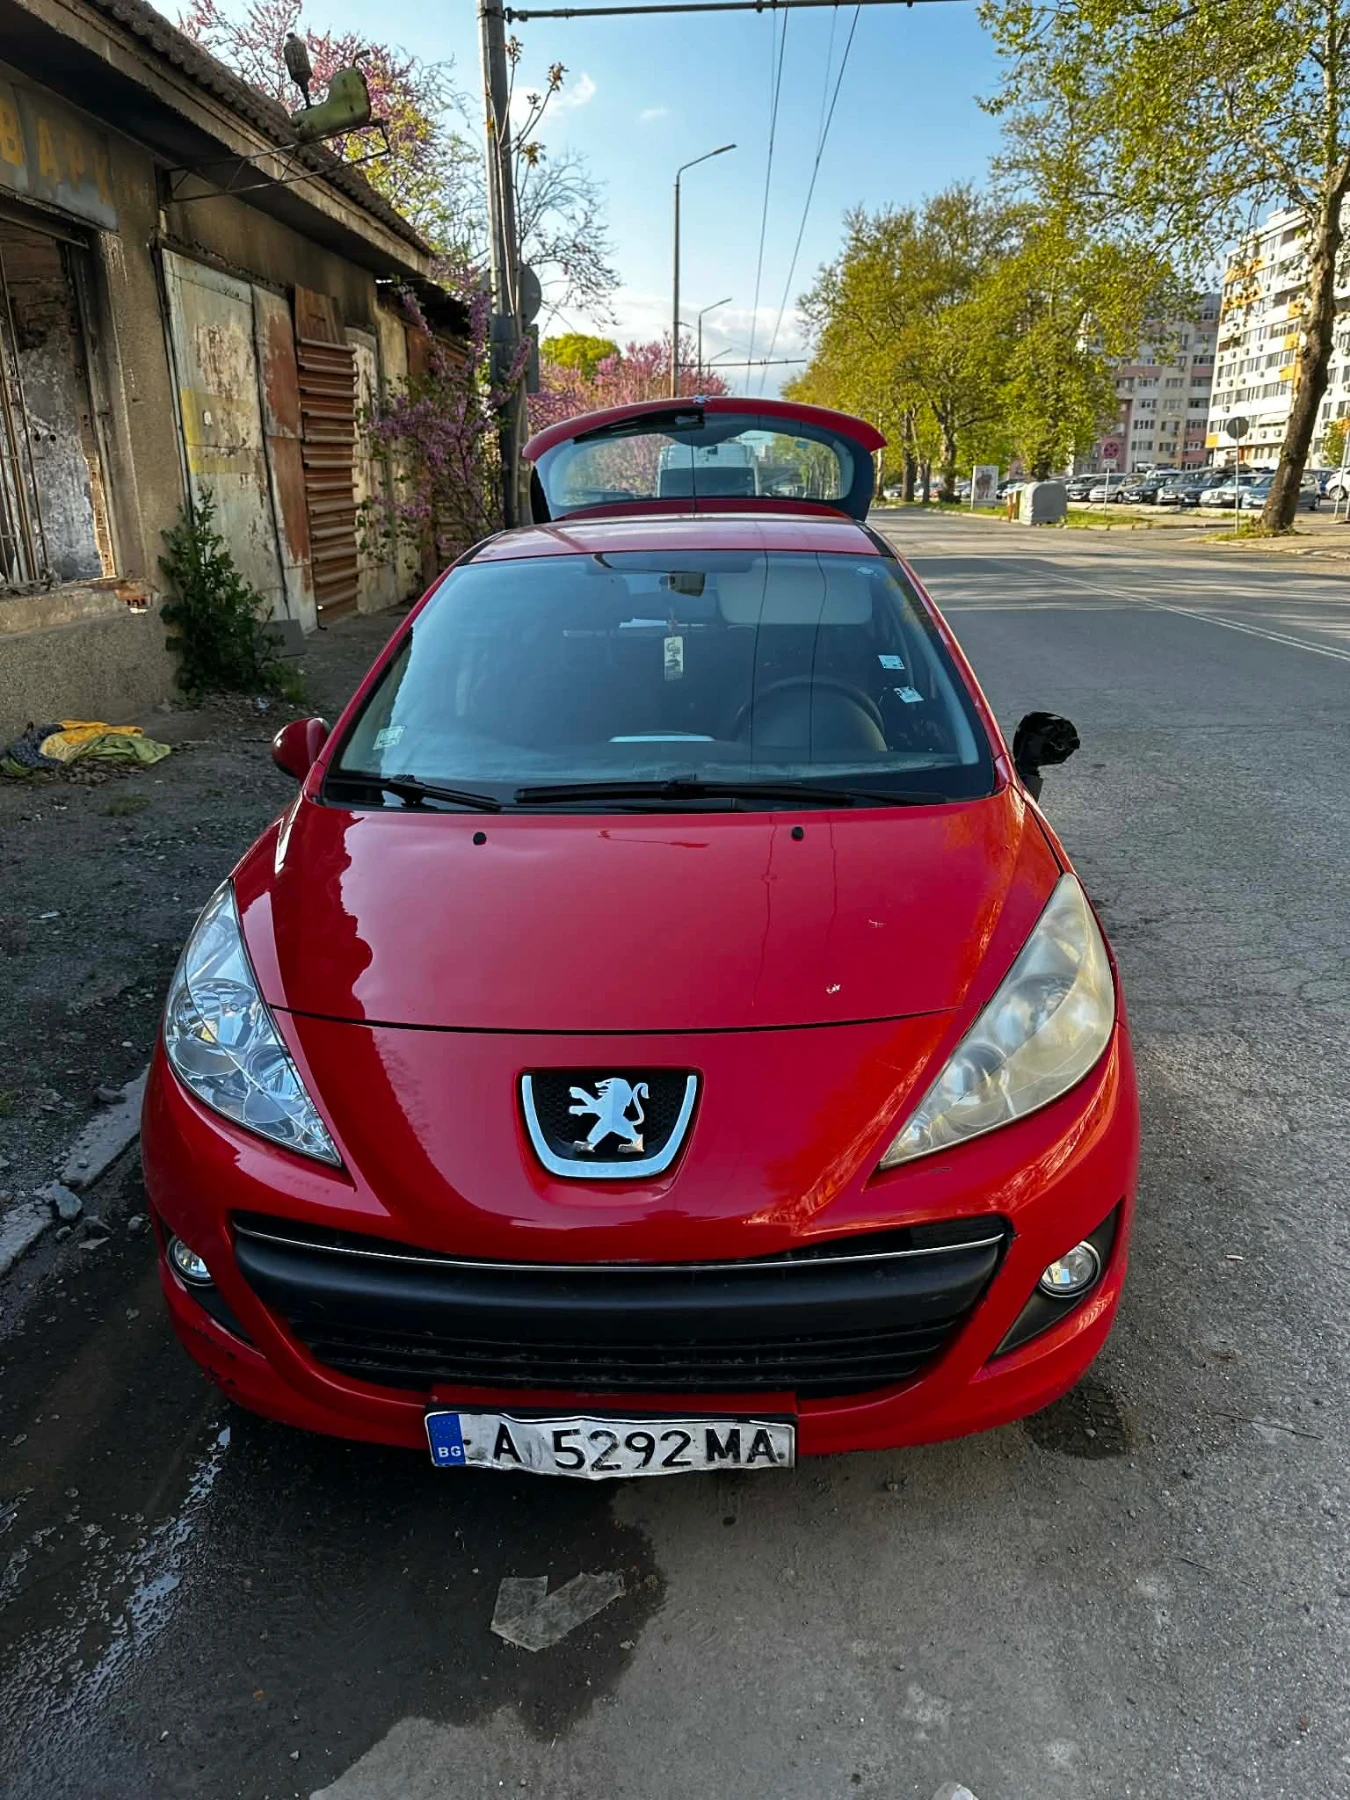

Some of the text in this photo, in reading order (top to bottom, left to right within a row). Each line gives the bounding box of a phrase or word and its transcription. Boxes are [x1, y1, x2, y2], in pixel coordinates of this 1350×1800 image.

[438, 1446, 462, 1458] BG
[493, 1422, 779, 1472] A 5292 MA
